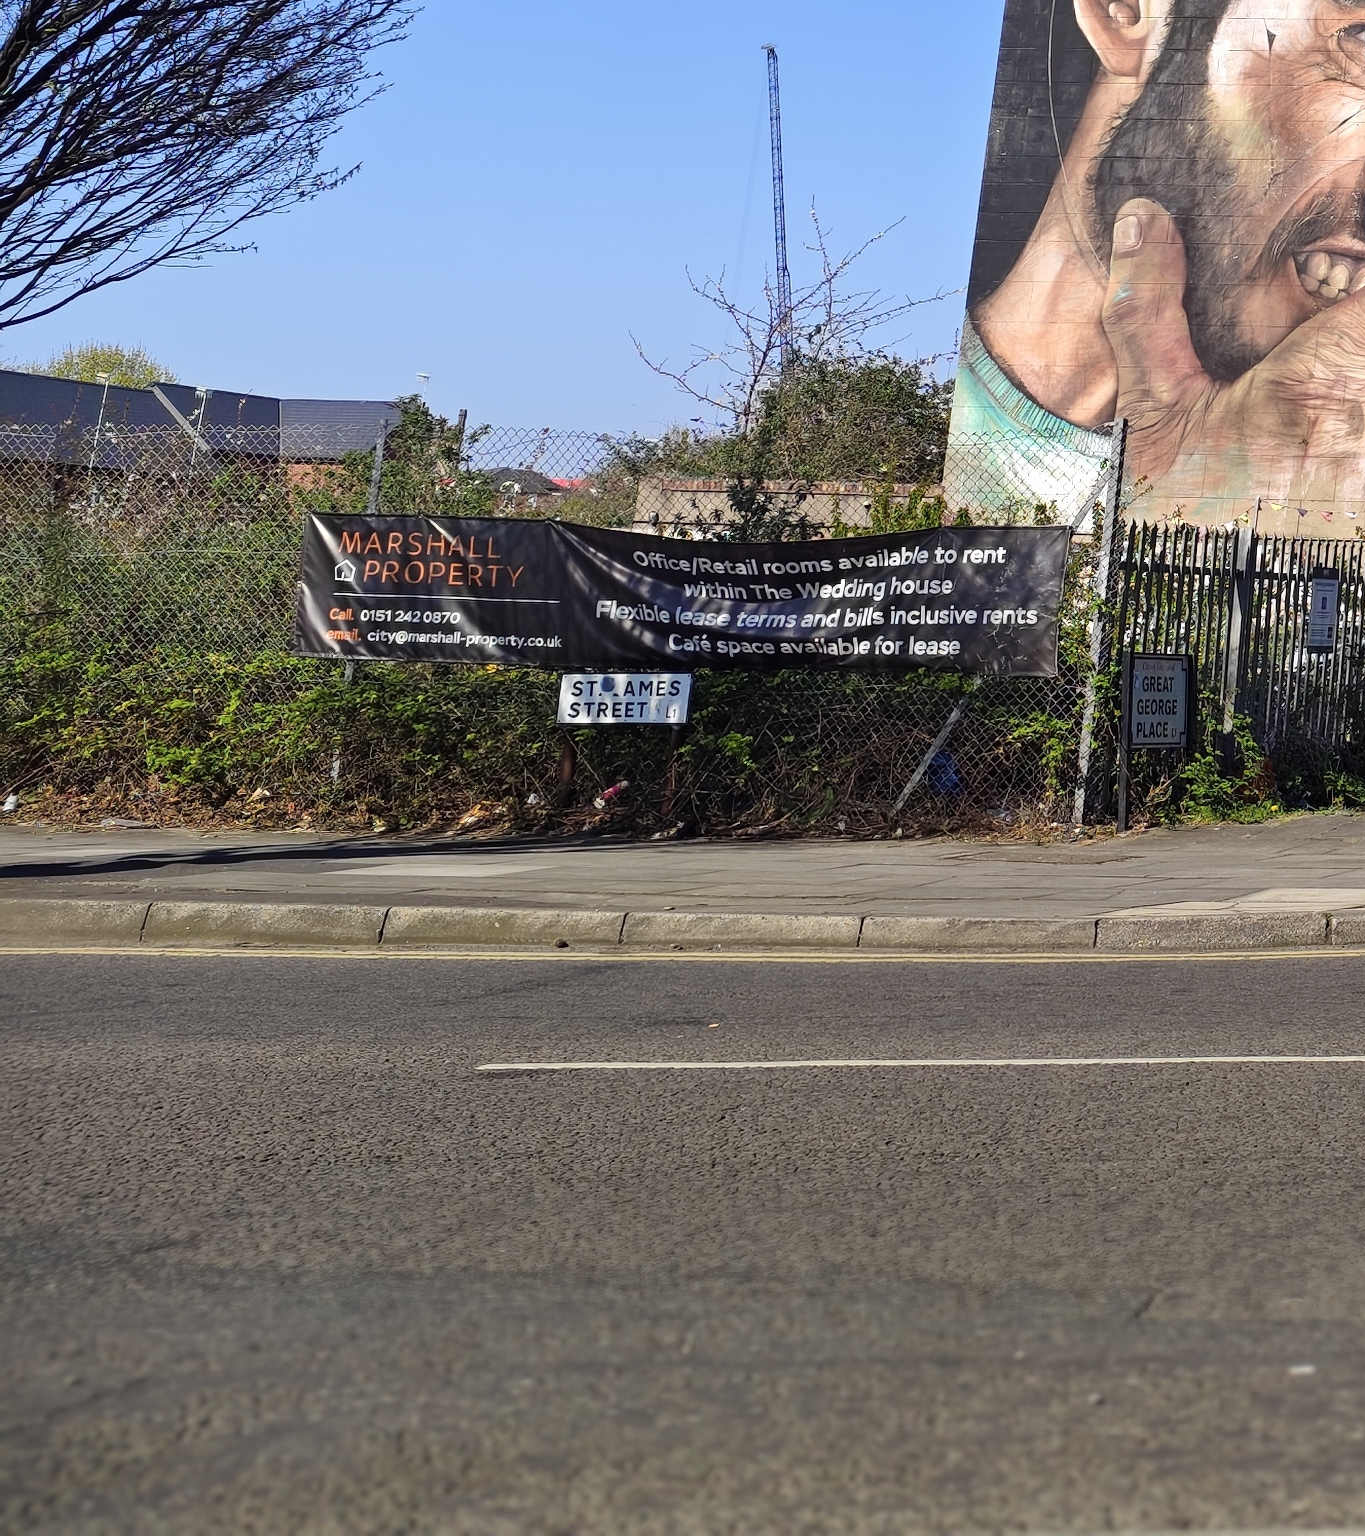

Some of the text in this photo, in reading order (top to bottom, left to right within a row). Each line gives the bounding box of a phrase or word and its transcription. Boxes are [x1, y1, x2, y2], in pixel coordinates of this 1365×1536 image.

[338, 531, 501, 559] MARSHALL
[633, 546, 1007, 576] Office/Retail rooms available to rent
[363, 560, 524, 588] PROPERTY
[684, 576, 954, 602] within The Wedding house
[329, 608, 462, 625] Call. 0151 242 0870
[596, 600, 1038, 628] Flexible lease terms and bills inclusive rents
[326, 628, 563, 649] email. city@marshall-property.co.uk
[668, 633, 961, 658] Café space available for lease
[571, 680, 682, 697] ST. AMES
[1142, 676, 1175, 693] GREAT
[567, 702, 676, 718] STREET L1
[1137, 699, 1178, 716] GEORGE
[1136, 722, 1168, 738] PLACE
